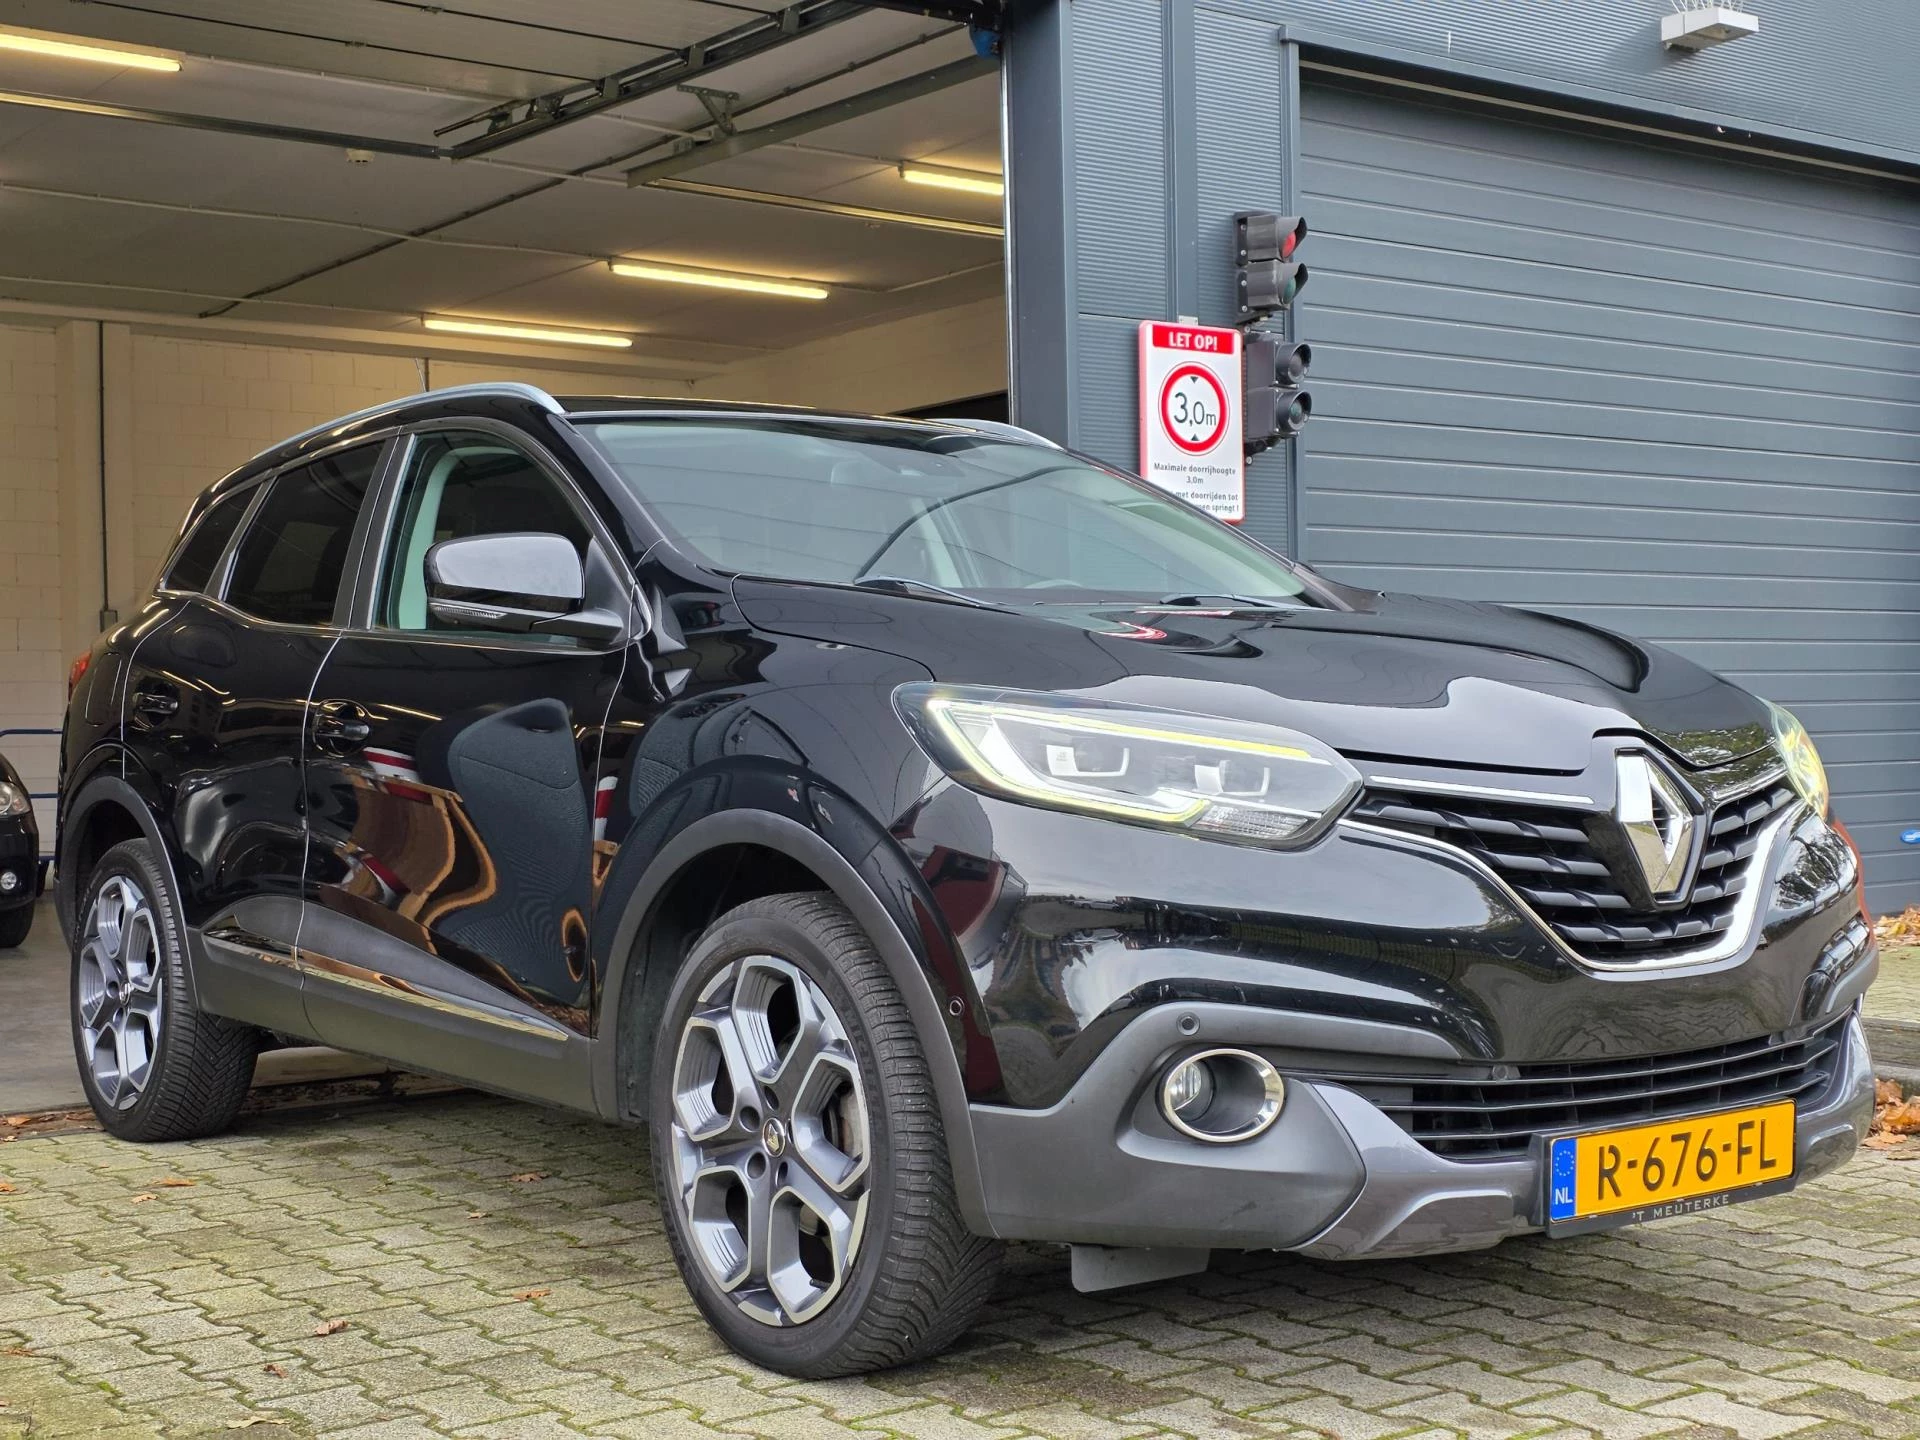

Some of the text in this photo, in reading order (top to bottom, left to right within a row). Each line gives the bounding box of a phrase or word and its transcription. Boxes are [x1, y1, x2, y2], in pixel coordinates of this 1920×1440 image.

[1168, 331, 1218, 351] LET OP!
[1173, 392, 1217, 427] 3,0m
[1153, 462, 1236, 476] Maximale doorrijhoogte
[1186, 475, 1204, 484] 3,0m
[1190, 491, 1227, 502] doorrijden
[1228, 493, 1239, 501] tot
[1597, 1119, 1777, 1201] R-676-FL
[1554, 1187, 1573, 1205] NL
[1653, 1194, 1730, 1219] MEUTERKE
